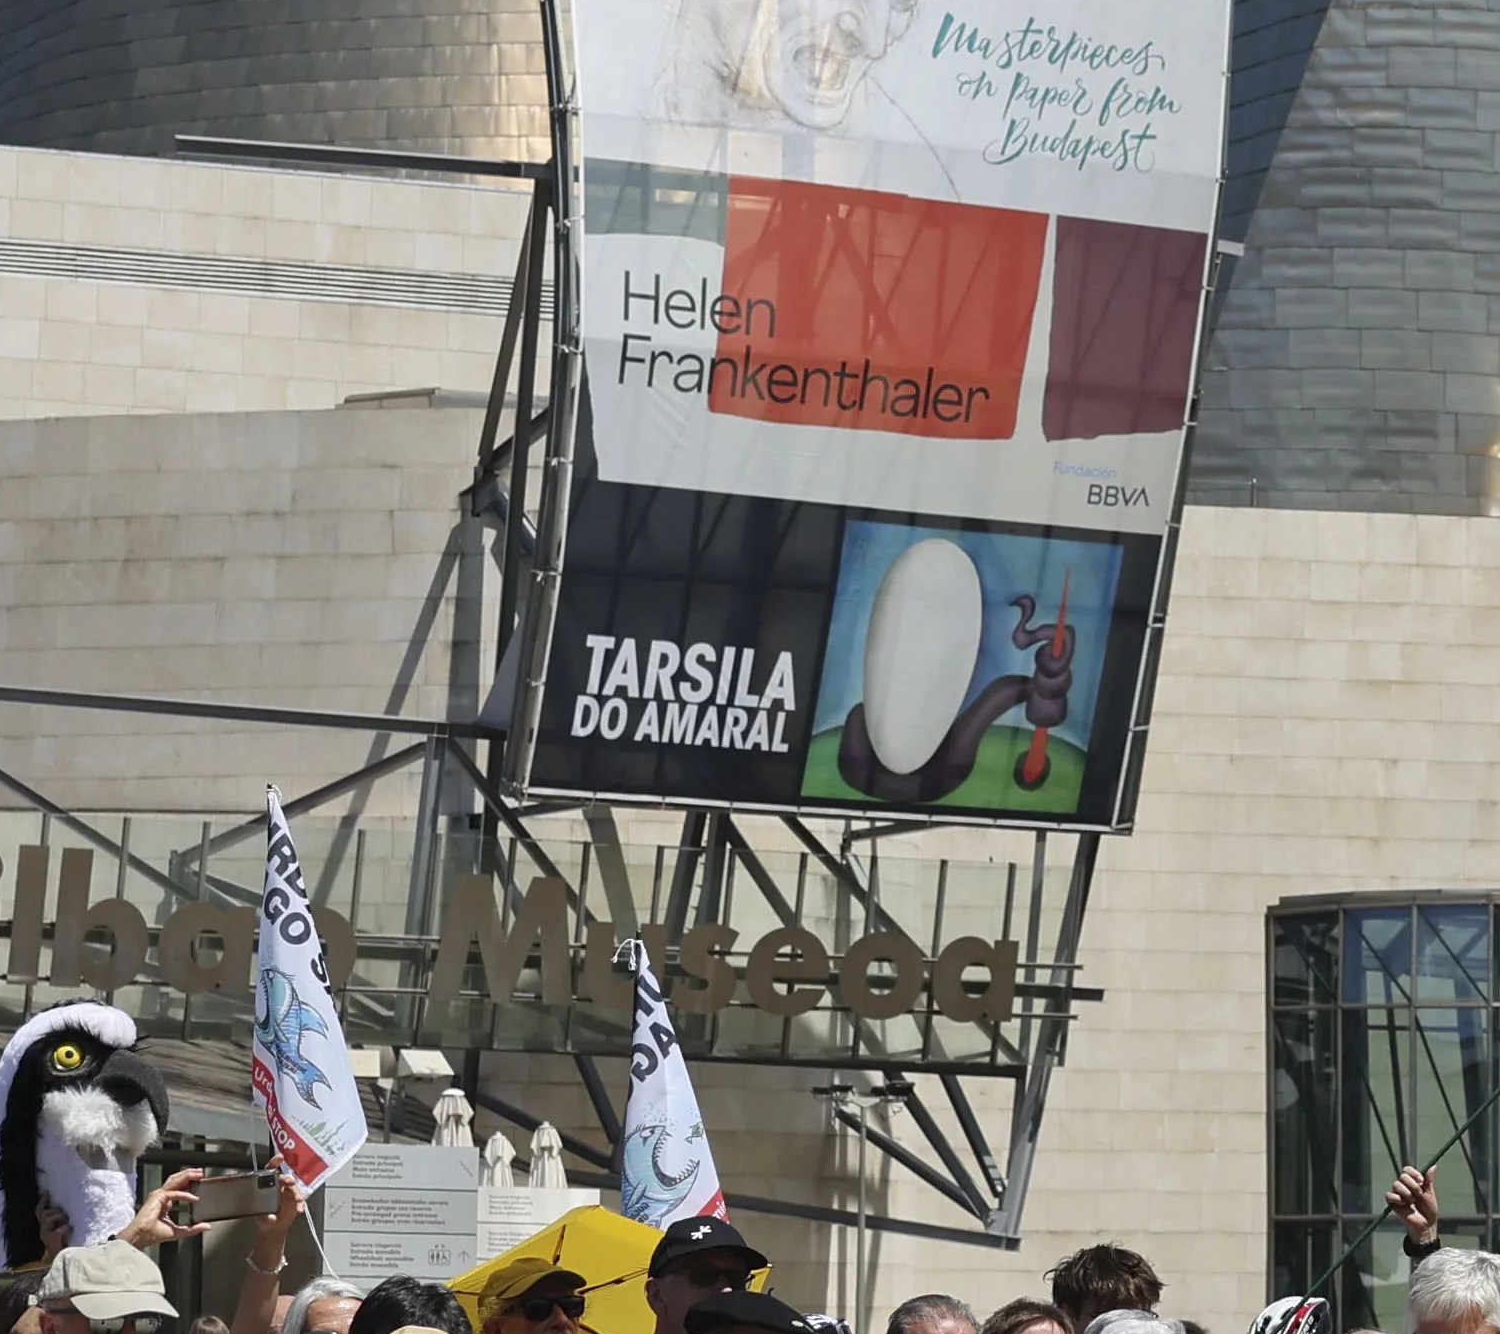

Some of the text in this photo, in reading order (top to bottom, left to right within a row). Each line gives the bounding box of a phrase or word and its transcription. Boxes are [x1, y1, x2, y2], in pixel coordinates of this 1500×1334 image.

[932, 12, 1165, 76] Masterpieces
[956, 71, 998, 100] on
[1099, 77, 1182, 126] from
[982, 117, 1157, 173] Budapest
[624, 270, 776, 338] Helen
[618, 333, 990, 423] Frankenthaler
[1053, 461, 1117, 479] Fundación
[1087, 484, 1149, 507] BBVA
[586, 634, 796, 711] TARSILA
[570, 694, 789, 753] DO AMARAL
[430, 873, 1019, 1024] Museoa
